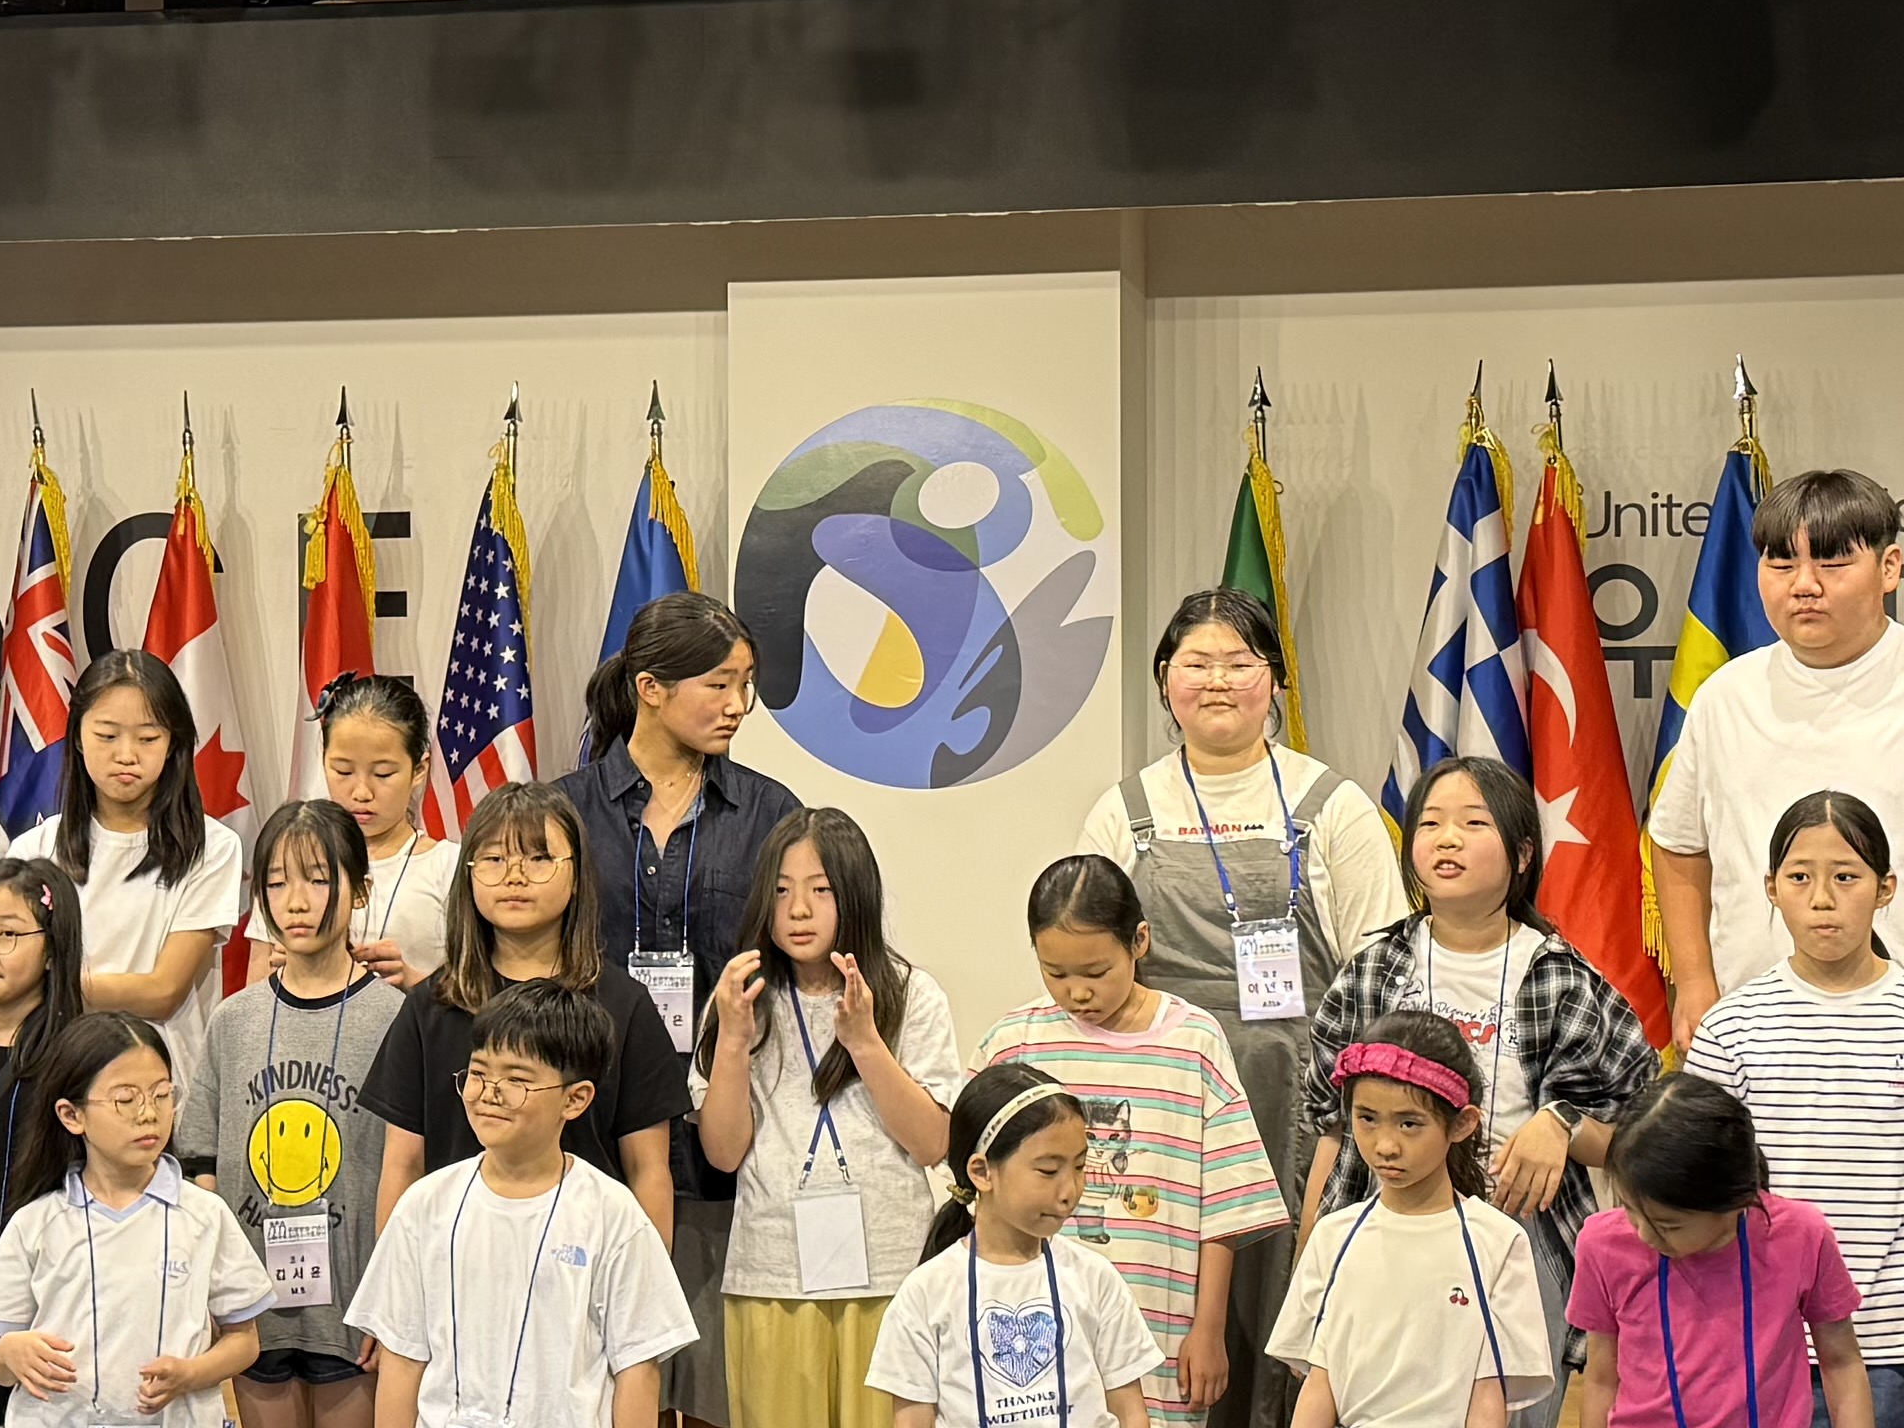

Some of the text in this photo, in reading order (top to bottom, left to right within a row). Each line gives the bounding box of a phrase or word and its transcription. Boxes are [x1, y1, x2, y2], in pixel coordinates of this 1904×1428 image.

[1584, 489, 1711, 539] Unite
[995, 1390, 1057, 1410] THANKS
[985, 1404, 1074, 1426] WEETHEAT
